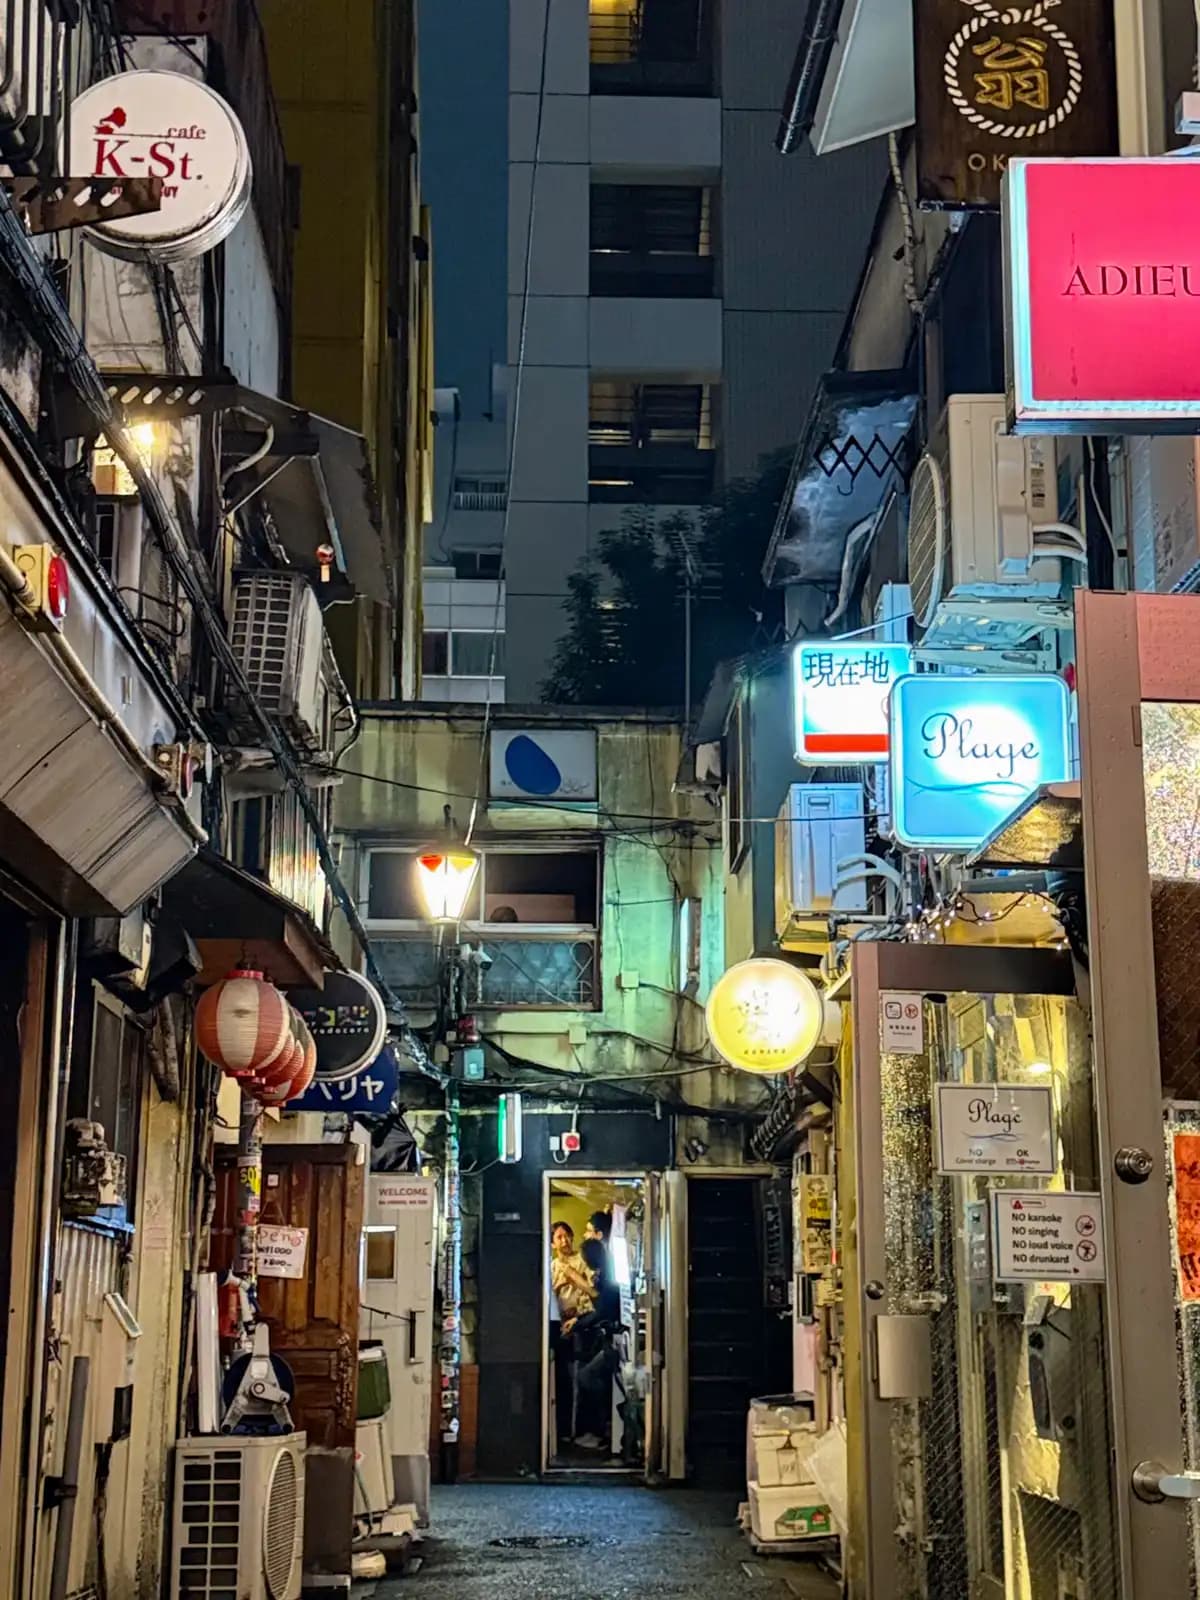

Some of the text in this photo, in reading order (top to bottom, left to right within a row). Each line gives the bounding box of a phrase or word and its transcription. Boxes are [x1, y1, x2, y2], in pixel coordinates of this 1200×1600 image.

[168, 125, 206, 139] cafe
[91, 138, 203, 180] K-St.
[804, 651, 889, 688] 現在地
[921, 712, 1039, 779] Plage
[968, 1098, 1022, 1132] Plage
[1016, 1149, 1029, 1157] OK
[379, 1187, 428, 1196] WELCOME
[1011, 1213, 1062, 1222] NO karaoke
[1012, 1227, 1059, 1237] NO singing
[1012, 1240, 1073, 1250] NO loud voice
[1013, 1254, 1070, 1263] NO drunkard
